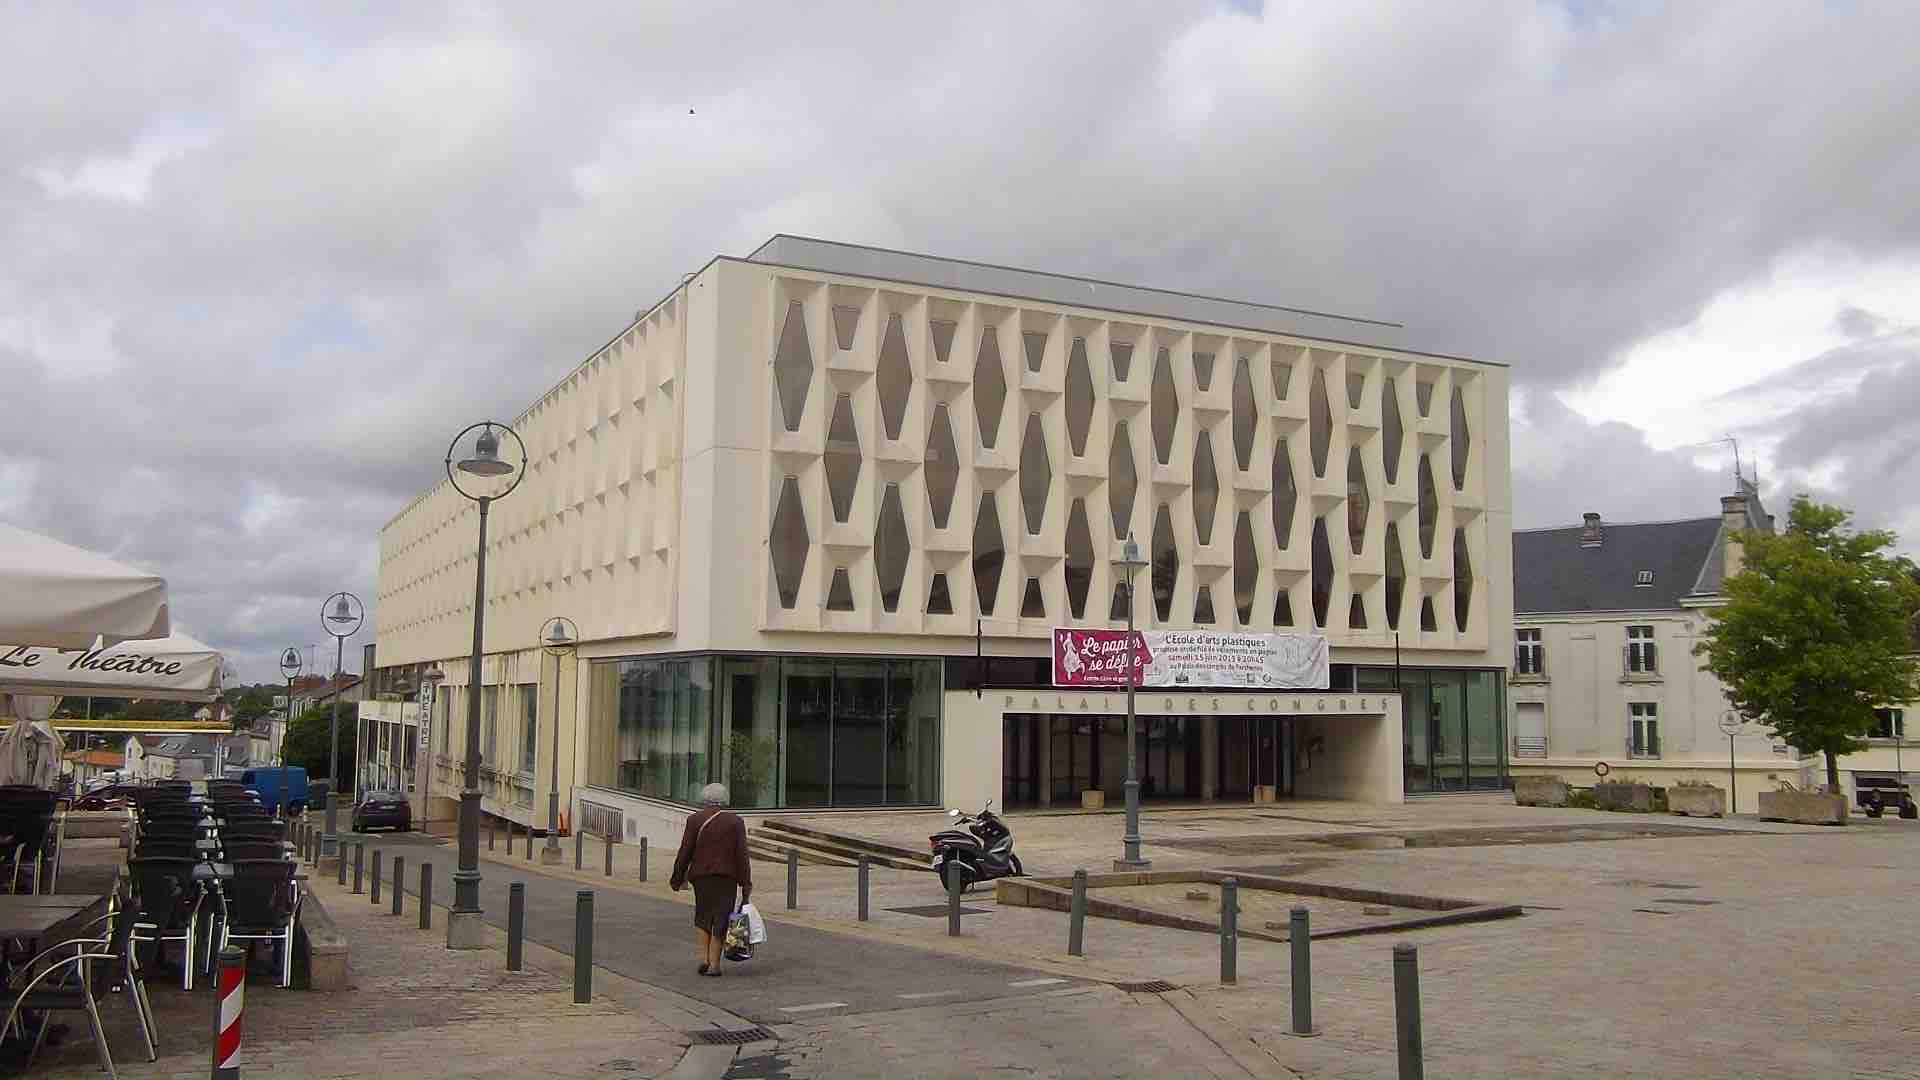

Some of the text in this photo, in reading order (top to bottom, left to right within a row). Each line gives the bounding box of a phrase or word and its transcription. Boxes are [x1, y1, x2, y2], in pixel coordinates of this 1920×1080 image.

[1080, 636, 1143, 658] Le papir
[1222, 636, 1265, 648] plastiques
[0, 645, 184, 676] Le Théâtre
[1088, 658, 1104, 671] se
[1164, 697, 1220, 711] DES
